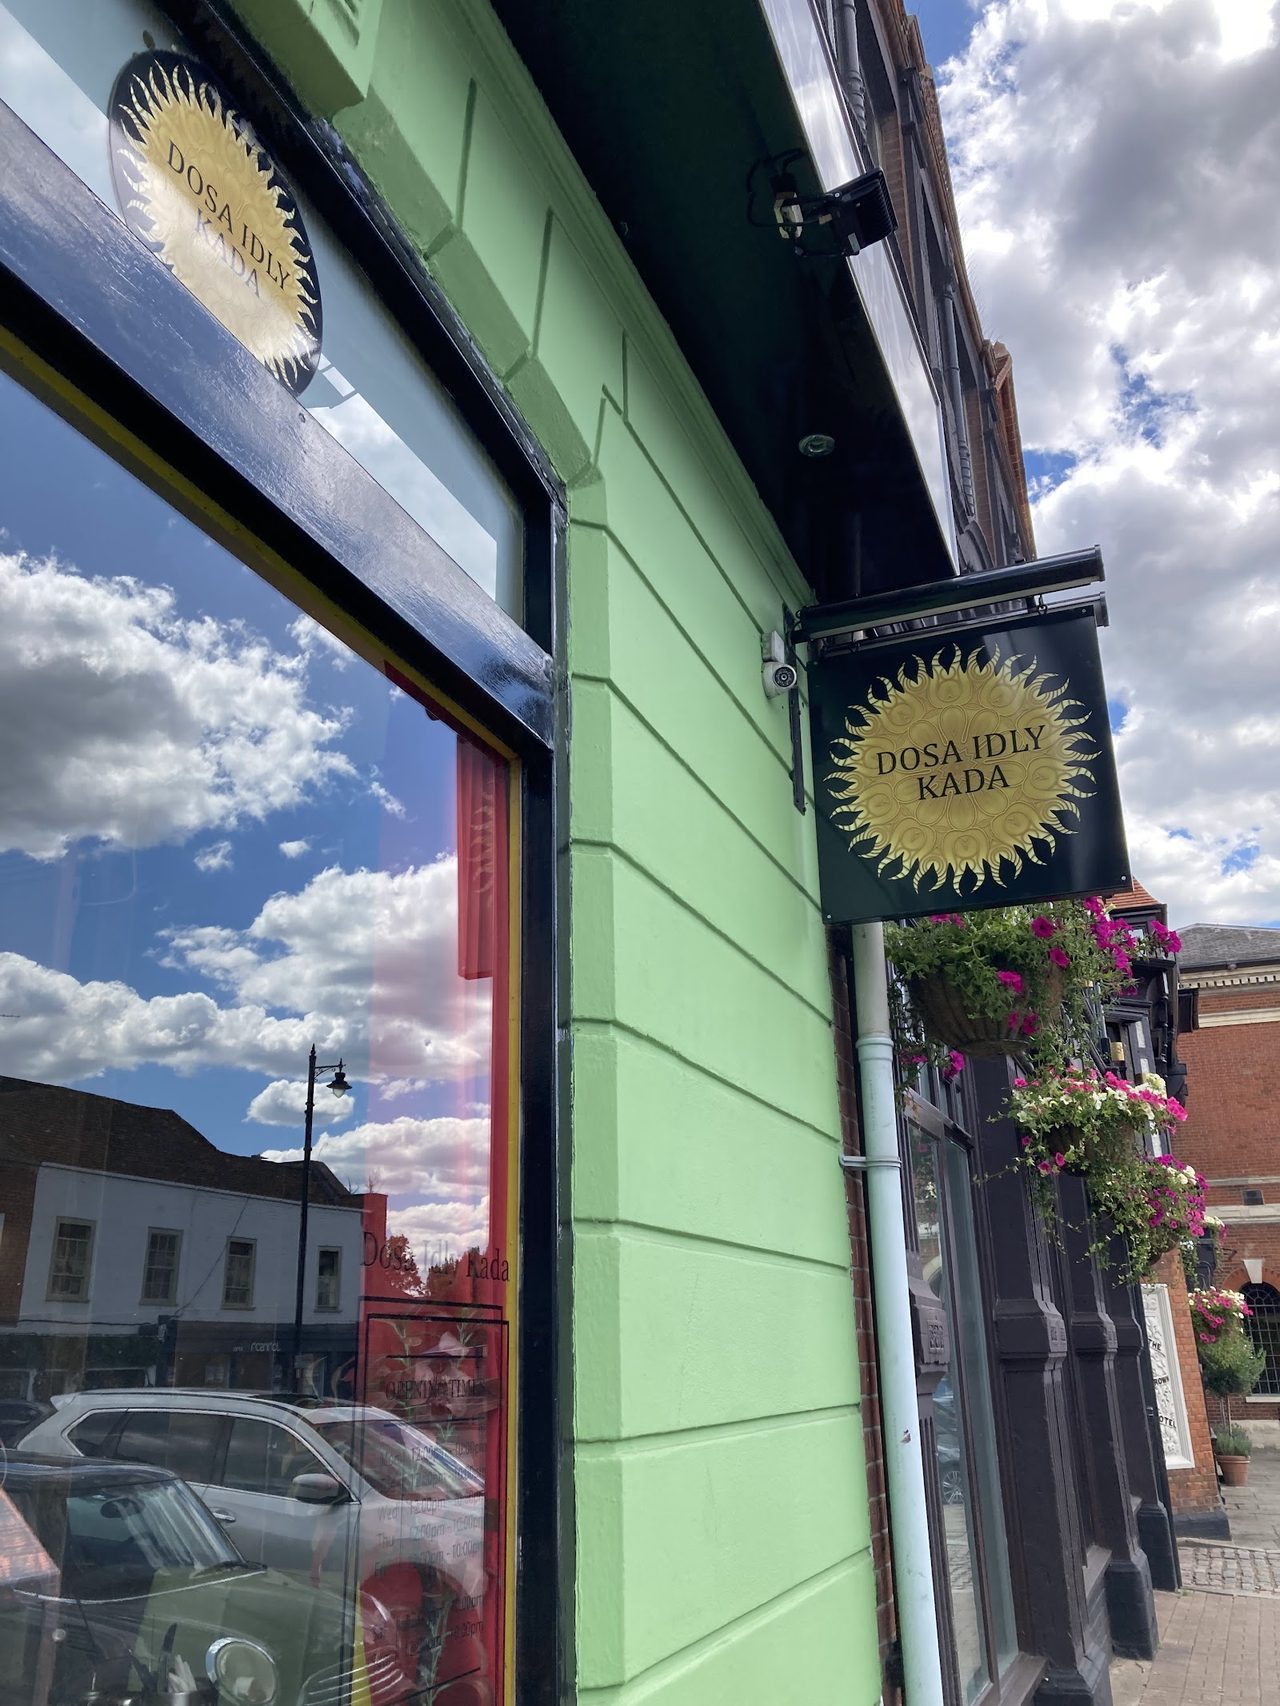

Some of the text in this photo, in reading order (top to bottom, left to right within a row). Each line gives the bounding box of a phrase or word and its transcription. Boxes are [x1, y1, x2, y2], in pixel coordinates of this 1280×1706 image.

[167, 138, 291, 291] DOSA IDLY
[194, 207, 261, 298] KADA
[876, 724, 1047, 776] DOSA IDLY
[916, 764, 1010, 801] KADA
[466, 1248, 510, 1282] Kada
[1153, 1375, 1170, 1386] ROWN
[1159, 1415, 1177, 1429] OTEL
